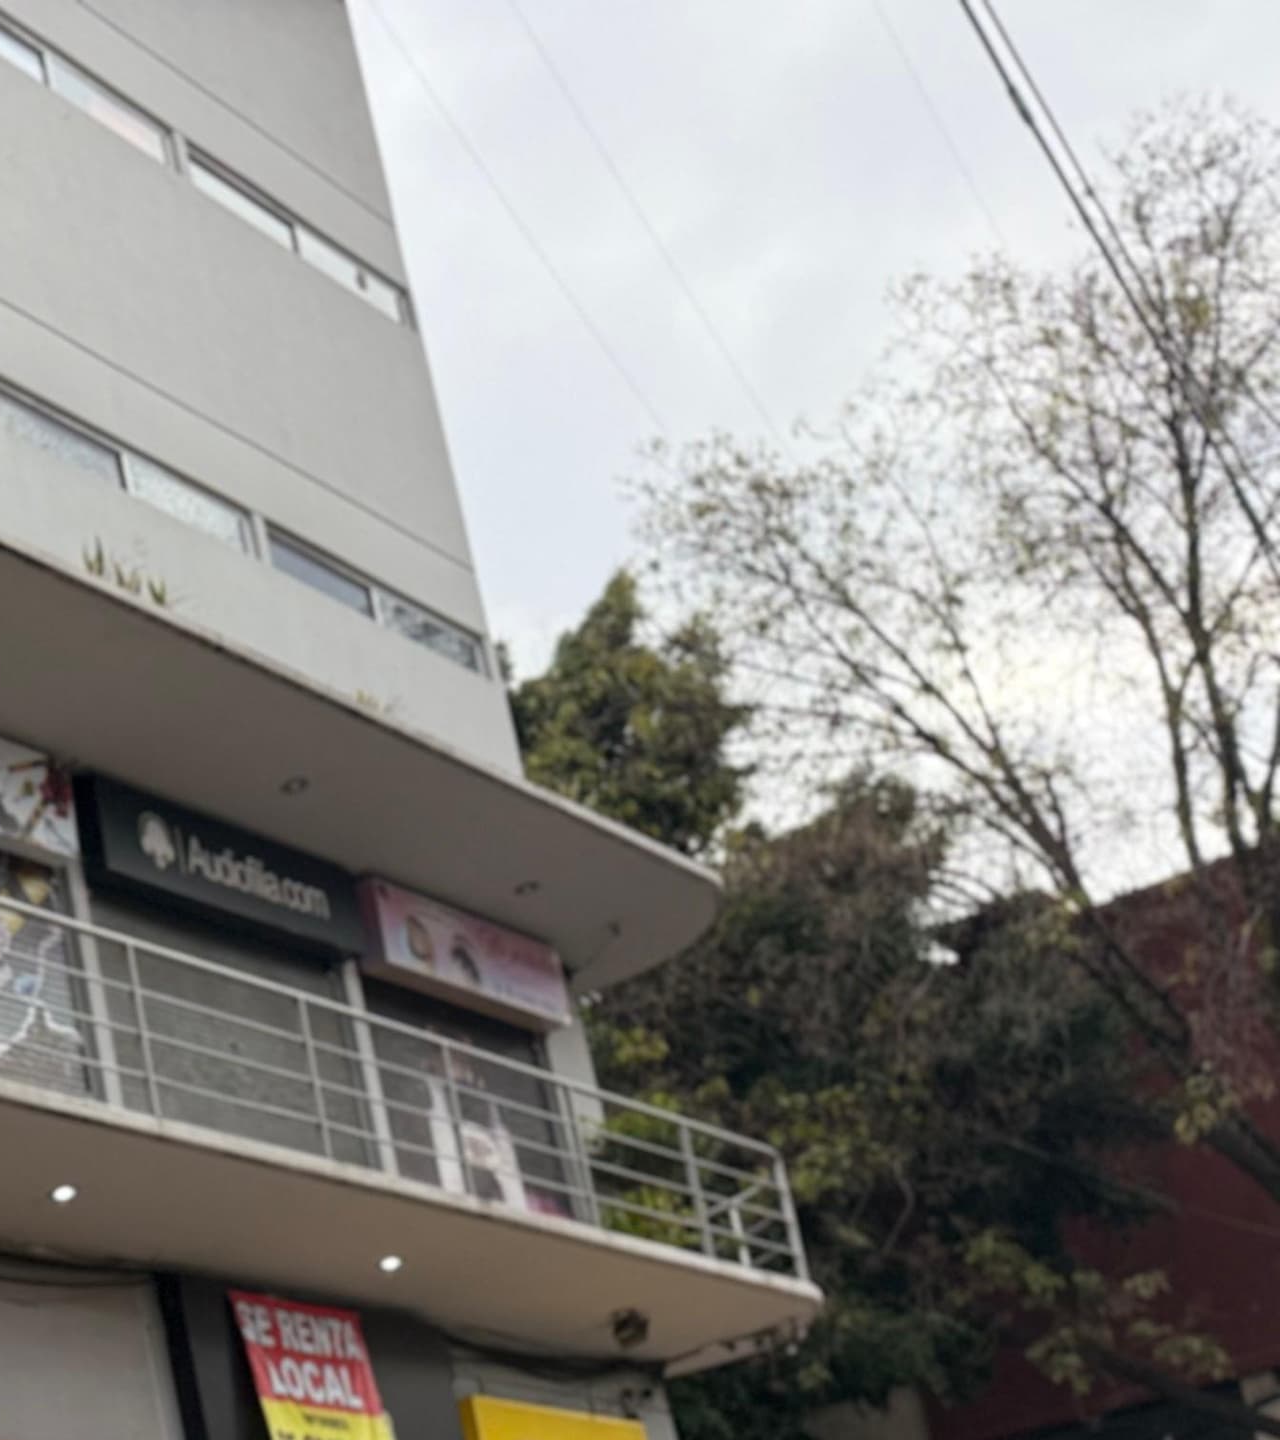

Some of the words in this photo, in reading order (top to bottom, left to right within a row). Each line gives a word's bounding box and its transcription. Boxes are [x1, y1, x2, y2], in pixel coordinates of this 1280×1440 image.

[237, 1301, 275, 1348] SE
[275, 1309, 366, 1361] RENTA
[267, 1356, 365, 1409] LOCAL
